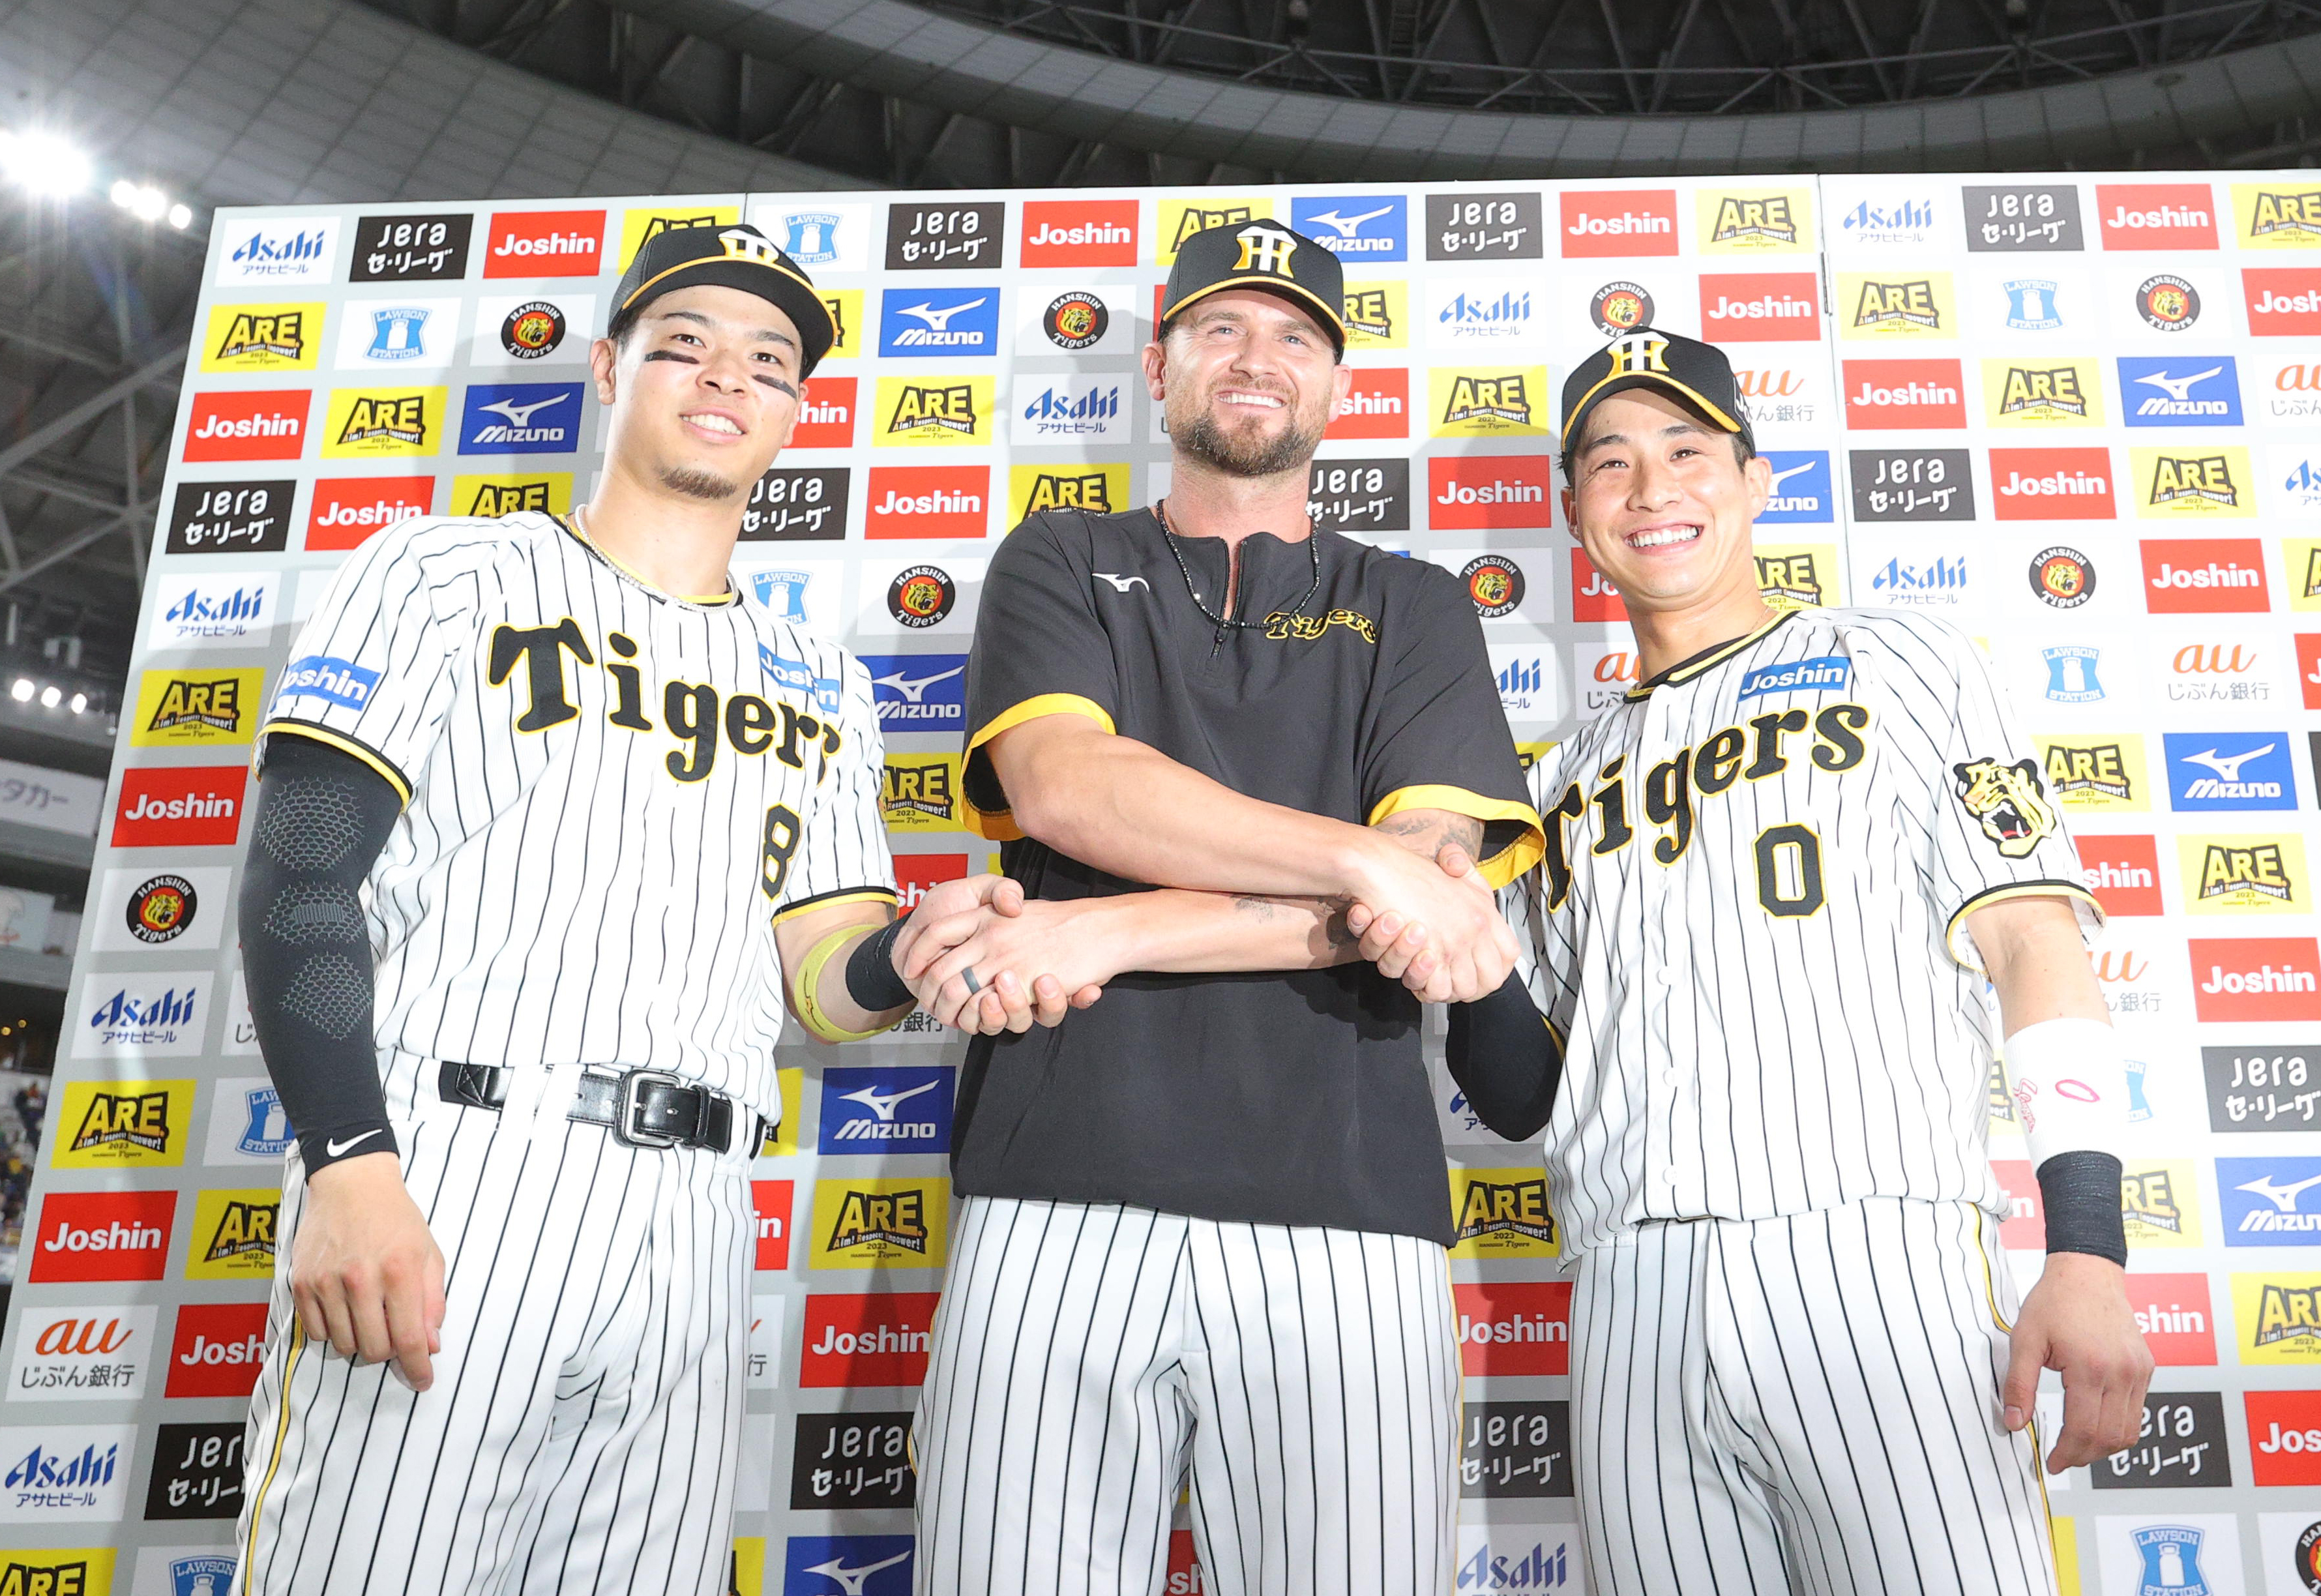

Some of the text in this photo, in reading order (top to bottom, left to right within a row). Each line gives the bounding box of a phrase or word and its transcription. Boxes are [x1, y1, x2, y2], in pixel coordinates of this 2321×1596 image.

[787, 213, 837, 226] LAWSON
[1569, 212, 1670, 235] Joshin
[1844, 200, 1932, 229] Asahi
[2108, 206, 2208, 228] Joshin
[1029, 222, 1130, 244] Joshin
[1857, 233, 1923, 242] アサヒビール
[233, 231, 323, 261] Asahi
[495, 233, 595, 256] Joshin
[243, 264, 308, 275] アサヒビール
[1597, 282, 1648, 301] HANSHIN
[2006, 282, 2055, 292] LAWSON
[2142, 276, 2191, 295] HANSHIN
[1050, 293, 1101, 312] HANSHIN
[1440, 292, 1530, 323] Asahi
[1709, 295, 1811, 319] Joshin
[2254, 290, 2321, 313] Josh
[376, 309, 427, 321] LAWSON
[509, 303, 561, 323] HANSHIN
[2011, 318, 2060, 328] STATION
[2149, 315, 2193, 332] Tigers
[893, 329, 983, 346] MIZUNO
[1051, 332, 1097, 349] Tigers
[1453, 327, 1520, 336] アサヒビール
[370, 347, 420, 359] STATION
[508, 342, 554, 358] Tigers
[1025, 387, 1117, 419] Asahi
[1339, 392, 1400, 414] shin
[1853, 382, 1957, 406] Joshin
[799, 402, 847, 423] hin
[2137, 398, 2228, 415] MIZUNO
[196, 413, 299, 438] Joshin
[473, 426, 564, 443] MIZUNO
[1038, 422, 1106, 433] アサヒビール
[1437, 480, 1541, 504] Joshin
[2000, 471, 2105, 495] Joshin
[875, 490, 980, 514] Joshin
[1466, 557, 1518, 576] HANSHIN
[2035, 548, 2085, 566] HANSHIN
[754, 572, 807, 584] LAWSON
[896, 567, 948, 587] HANSHIN
[1873, 557, 1966, 589] Asahi
[2152, 563, 2258, 588] Joshin
[166, 587, 263, 621] Asahi
[1887, 594, 1957, 604] アサヒビール
[2043, 591, 2088, 608] Tigers
[897, 610, 943, 627] Tigers
[179, 625, 246, 637] アサヒビール
[2044, 647, 2097, 659] LAWSON
[2173, 643, 2257, 673] au
[1741, 664, 1845, 695] Joshin
[2050, 689, 2103, 701] STATION
[2167, 682, 2269, 700] じぶん銀行
[2185, 780, 2281, 798] MIZUNO
[125, 793, 233, 820] Joshin
[1541, 702, 1869, 914] Tigers
[762, 803, 801, 901] 8
[1752, 822, 1827, 917] 0
[2084, 864, 2151, 888] shin
[137, 876, 192, 898] HANSHIN
[133, 921, 182, 943] Tigers
[2202, 966, 2315, 993] Joshin
[91, 988, 195, 1027] Asahi
[102, 1031, 177, 1044] アサヒビール
[835, 1119, 935, 1139] MIZUNO
[45, 1222, 161, 1251] Joshin
[1459, 1314, 1566, 1343] Joshin
[2136, 1305, 2204, 1334] shin
[35, 1318, 132, 1355] au
[812, 1325, 930, 1355] Joshin
[181, 1335, 263, 1365] Josh
[21, 1365, 135, 1388] じぶん銀行
[5, 1444, 117, 1488] Asahi
[16, 1492, 96, 1507] アサヒビール
[2138, 1530, 2198, 1544] LAWSON
[177, 1562, 234, 1575] LAWSON
[1458, 1543, 1566, 1589] Asahi
